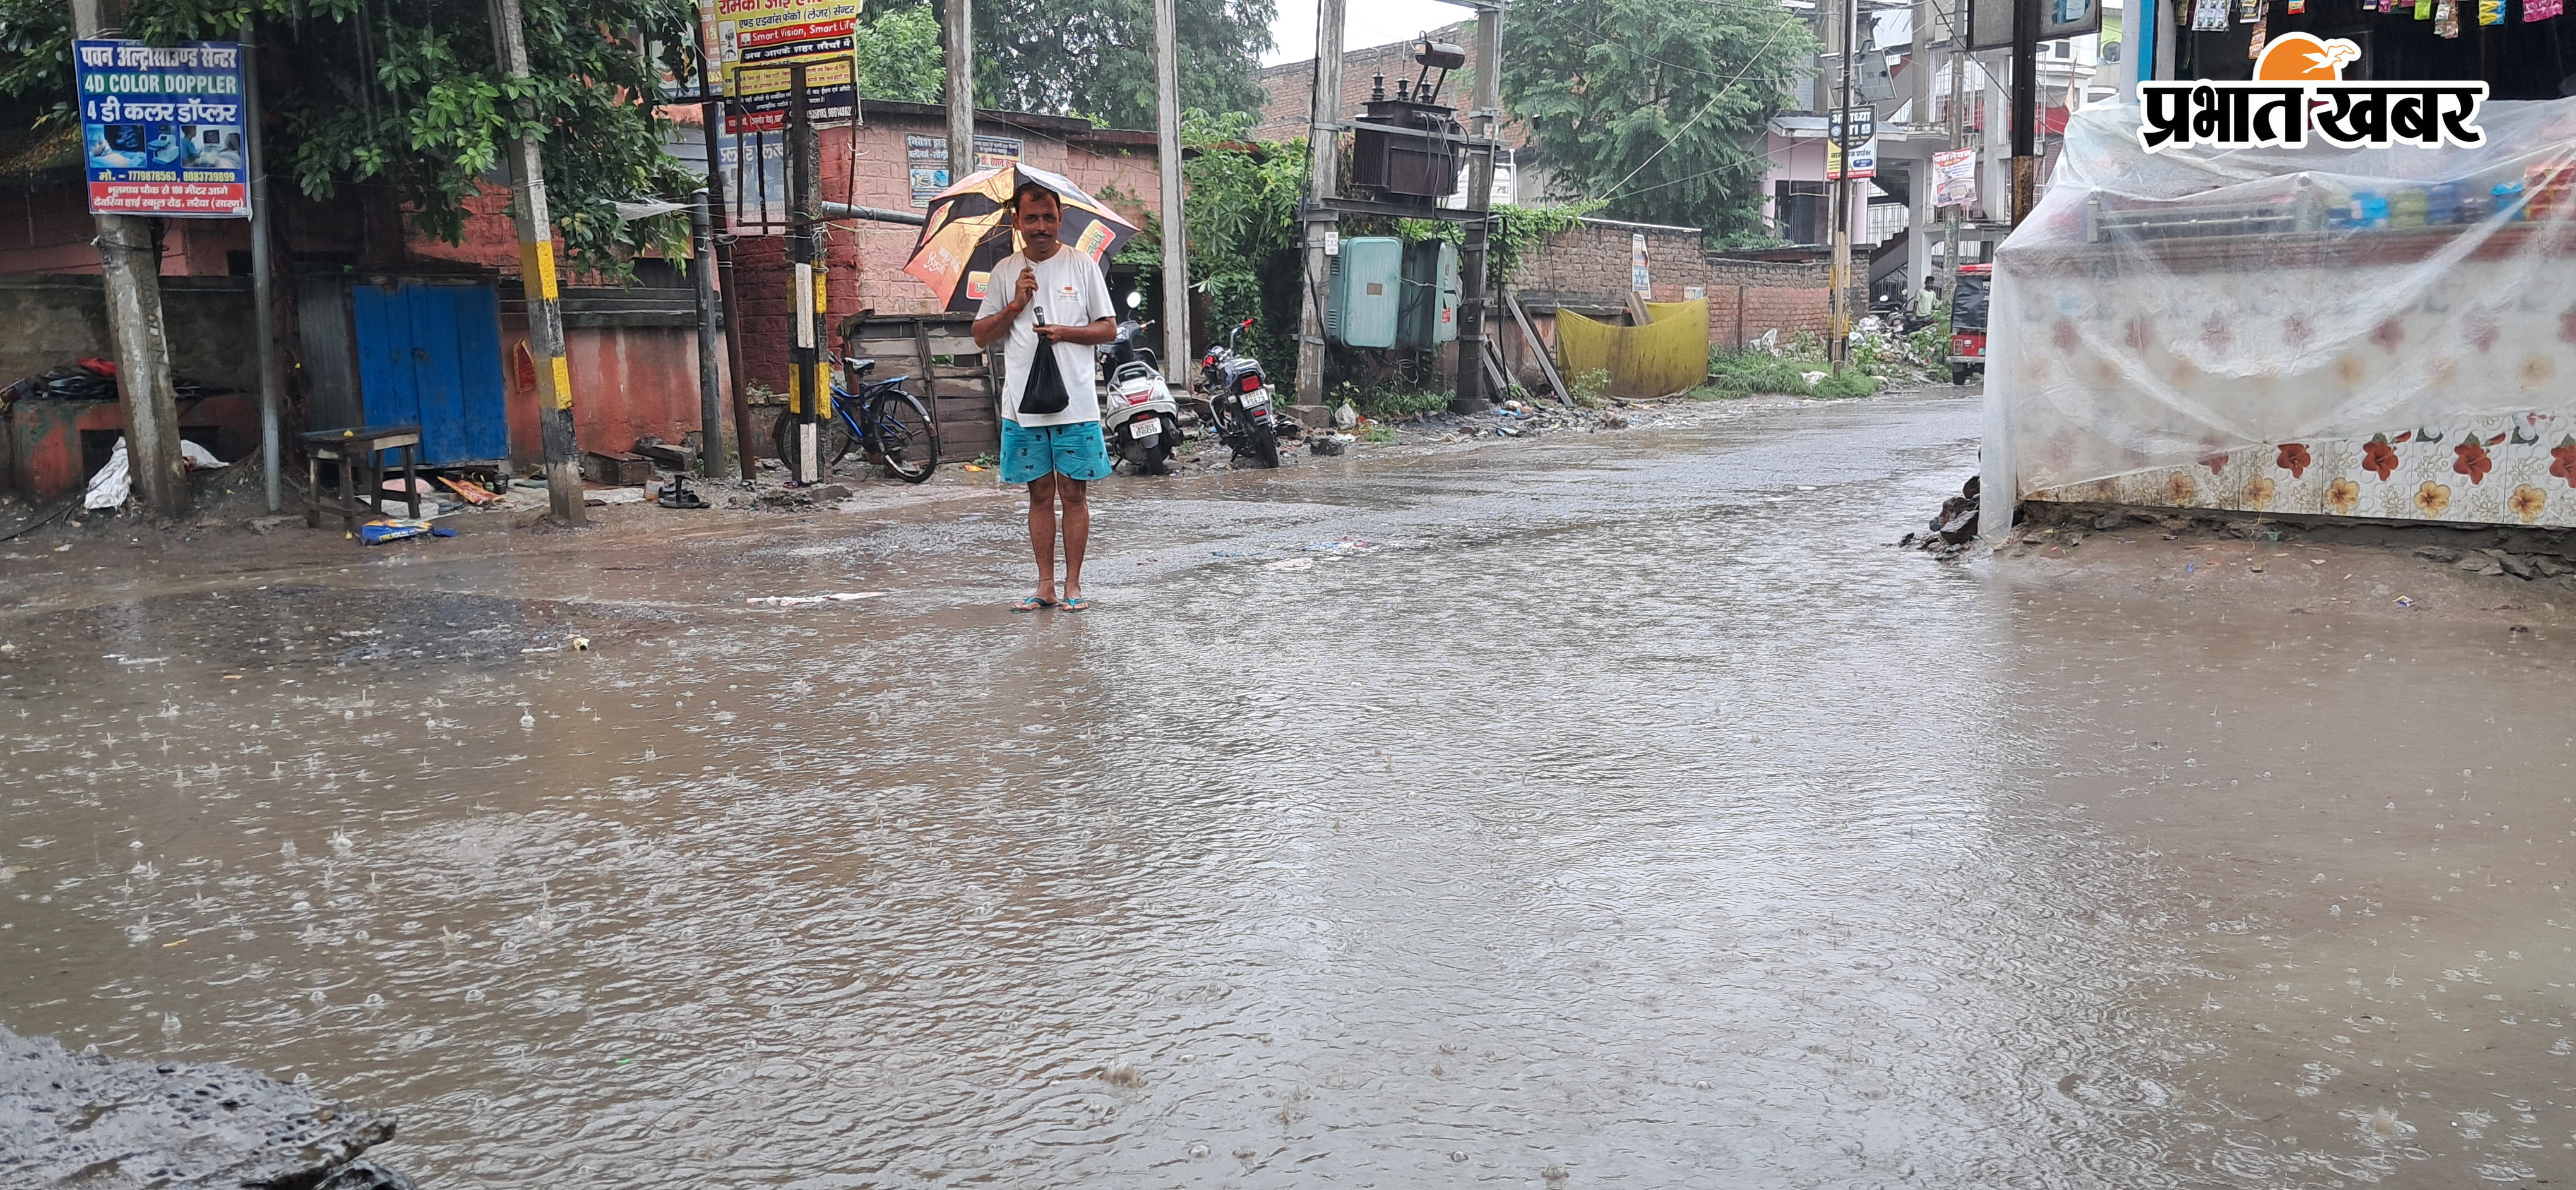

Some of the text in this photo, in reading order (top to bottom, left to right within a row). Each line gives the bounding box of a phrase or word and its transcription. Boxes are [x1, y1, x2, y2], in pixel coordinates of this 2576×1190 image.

[739, 18, 753, 28] एण्ड
[756, 13, 781, 26] एडवांस
[804, 5, 831, 22] (लेजर)
[833, 4, 855, 16] सेन्टर
[753, 30, 778, 42] Smart
[780, 27, 806, 37] Vision,
[809, 22, 838, 34] Smart
[81, 47, 113, 66] पवन
[201, 42, 237, 68] सेन्टर
[744, 52, 761, 60] अब
[765, 46, 790, 58] आपके
[793, 44, 814, 54] शहर
[85, 75, 237, 93] 4D COLOR DOPPLER
[88, 95, 237, 123] 4 डी कलर डॉप्लर
[98, 169, 116, 181] मो.
[161, 184, 169, 194] से
[171, 186, 183, 195] 100
[184, 184, 207, 195] मीटर
[208, 184, 228, 195] आगे
[142, 199, 165, 210] स्कूल
